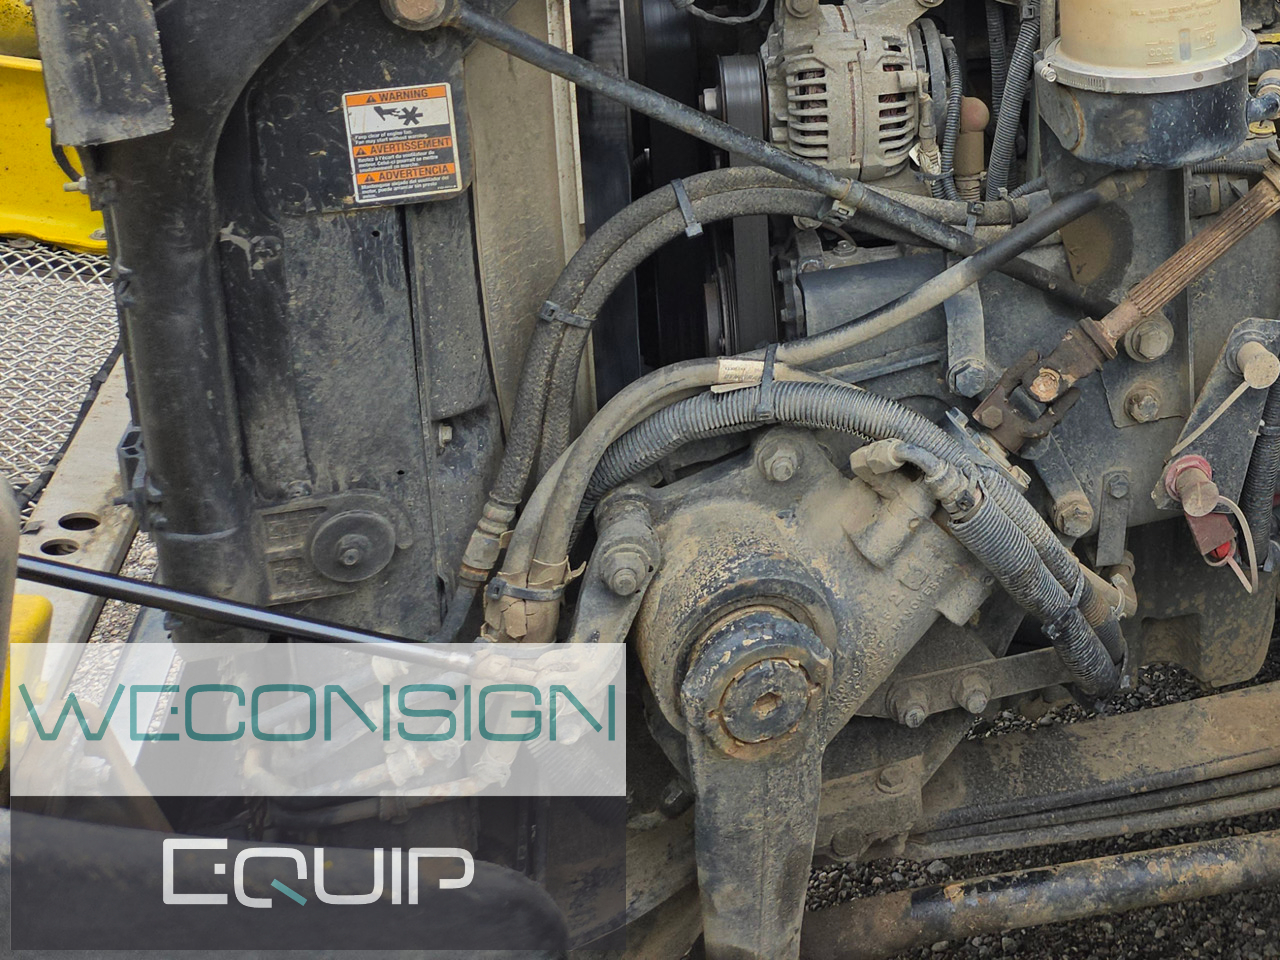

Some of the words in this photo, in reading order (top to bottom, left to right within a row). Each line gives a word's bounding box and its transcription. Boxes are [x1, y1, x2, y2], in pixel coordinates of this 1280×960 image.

[379, 89, 428, 102] WARNING
[370, 137, 450, 154] AVERTISSEMENT
[378, 165, 449, 181] ADVERTENCIA
